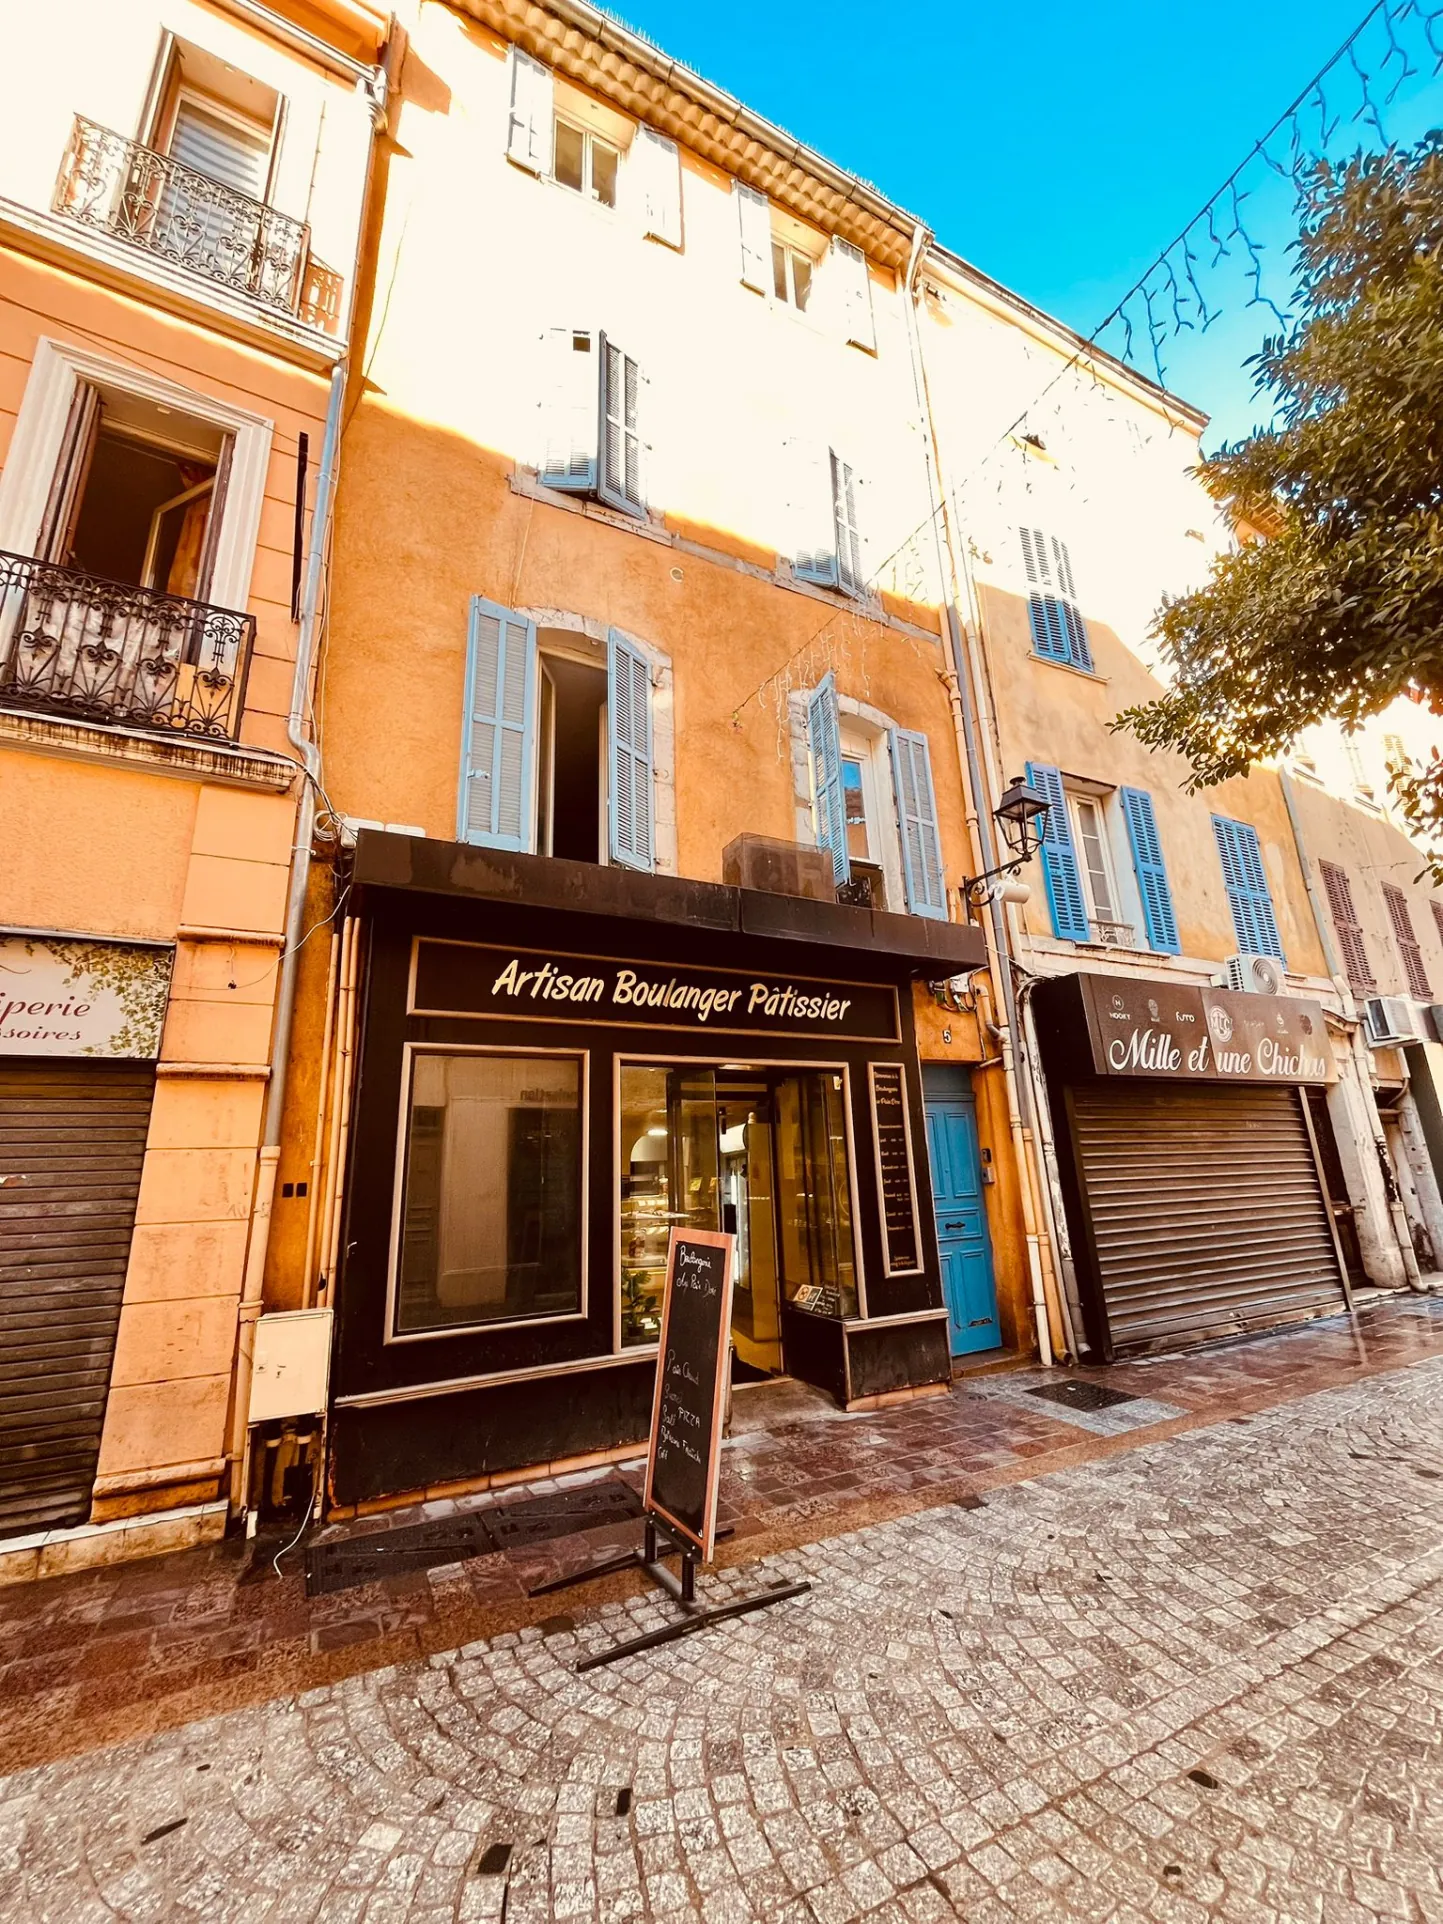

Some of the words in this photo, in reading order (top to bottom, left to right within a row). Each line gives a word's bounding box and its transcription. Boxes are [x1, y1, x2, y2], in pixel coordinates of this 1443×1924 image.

[491, 959, 605, 1003] Artisan
[612, 969, 742, 1022] Boulanger
[747, 983, 851, 1021] Pâtissier
[942, 1029, 952, 1043] 5
[1109, 1028, 1182, 1071] Mille
[1187, 1036, 1209, 1072] et
[1217, 1051, 1252, 1074] une
[1257, 1037, 1326, 1077] Chichas
[677, 1406, 700, 1429] PIZZA
